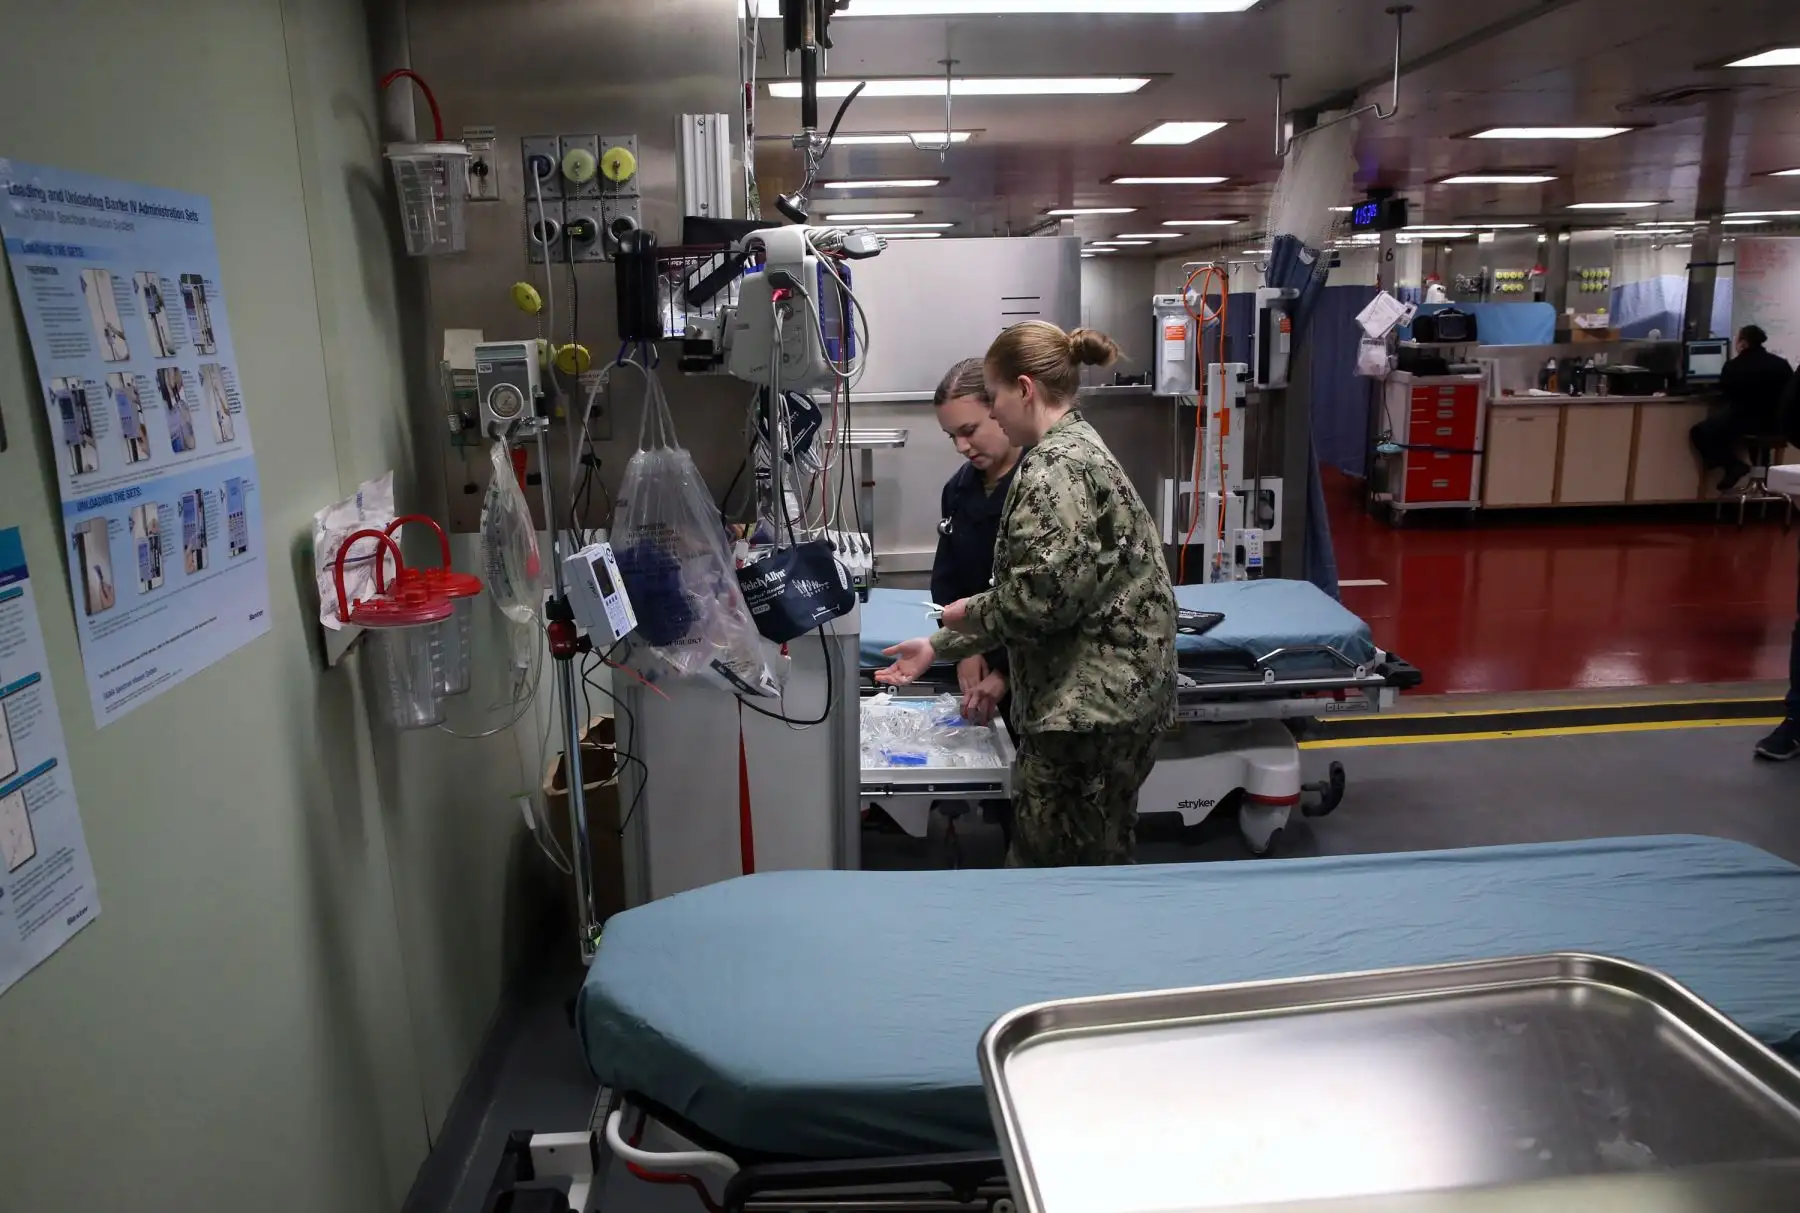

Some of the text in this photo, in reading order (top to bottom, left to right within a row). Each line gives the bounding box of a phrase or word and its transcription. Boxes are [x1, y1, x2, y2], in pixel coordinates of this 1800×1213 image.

[8, 183, 47, 203] Loading
[48, 189, 64, 203] and
[66, 191, 104, 210] Unloading
[139, 202, 184, 219] Administration
[1386, 248, 1394, 262] 6
[114, 490, 126, 503] THE
[1177, 798, 1215, 810] stryker
